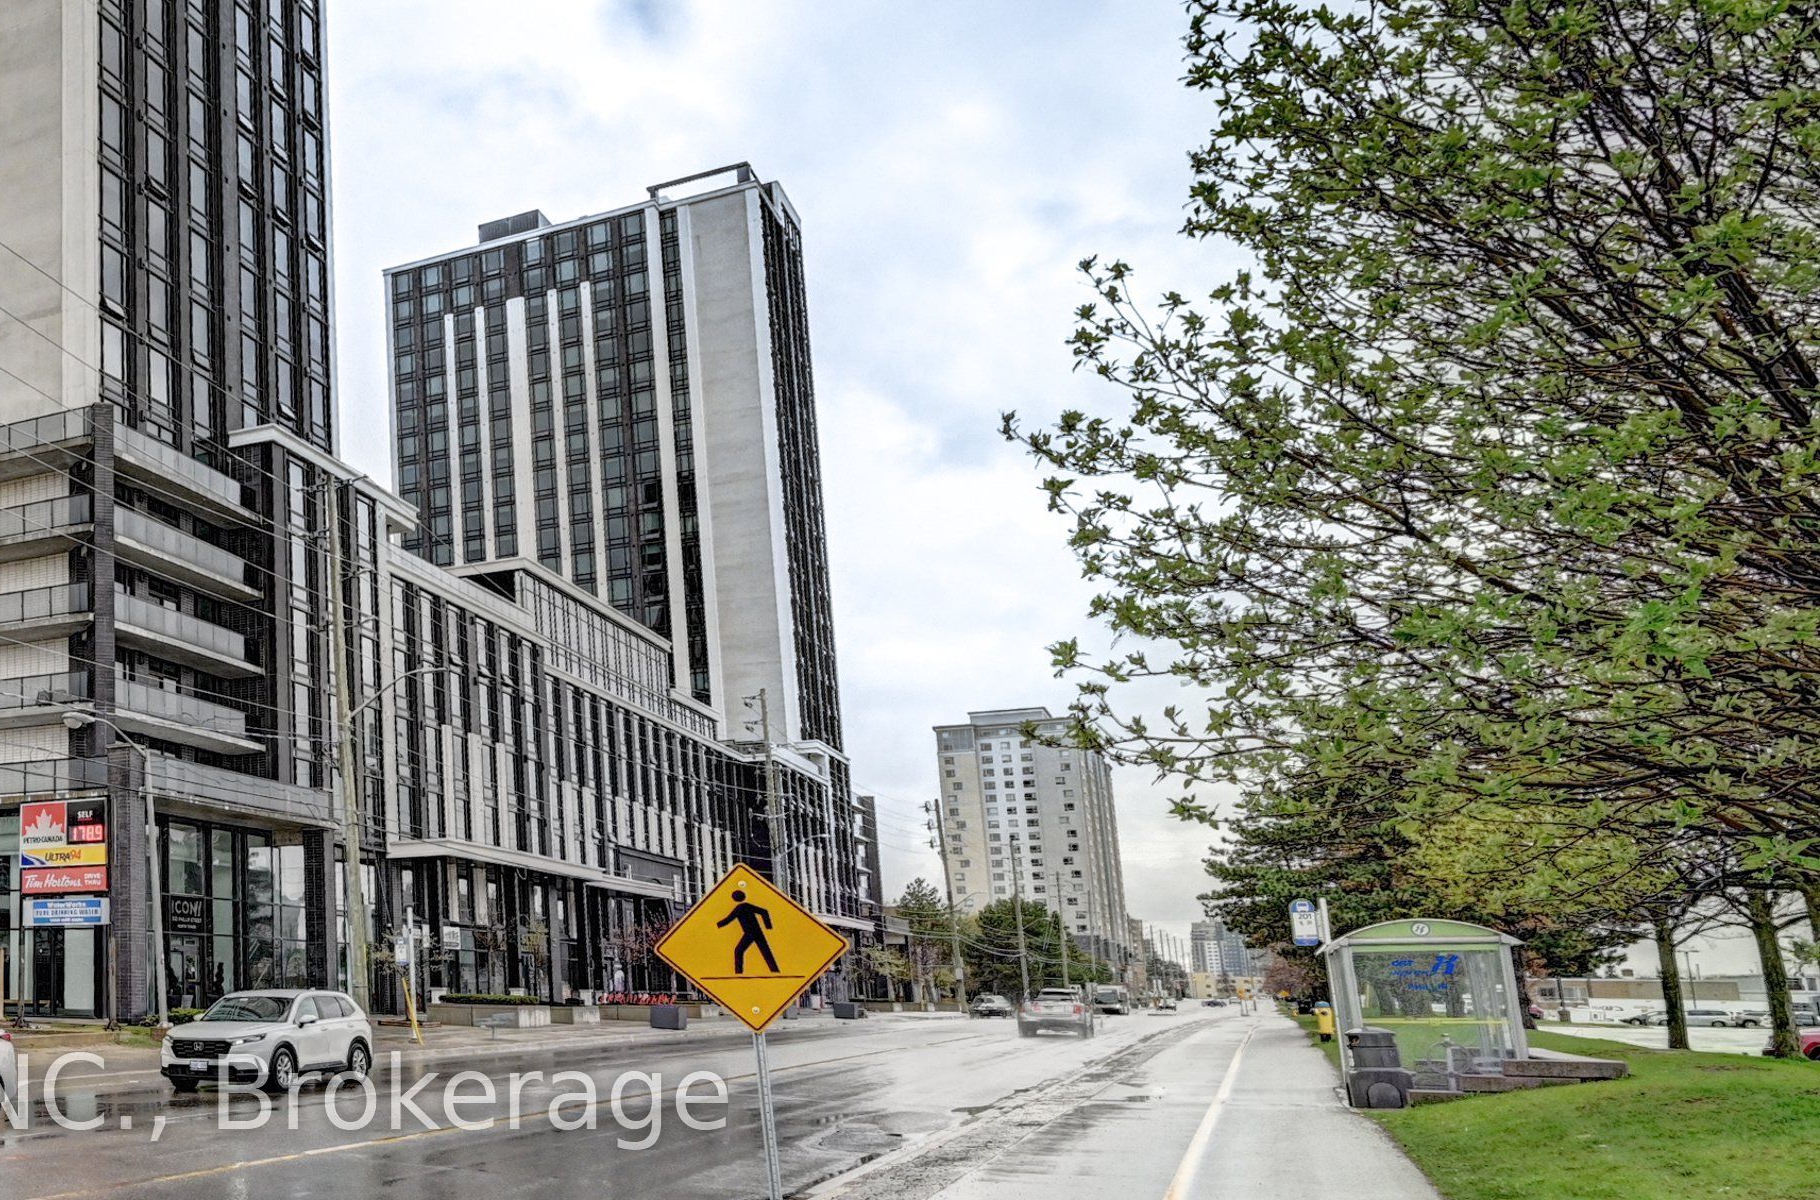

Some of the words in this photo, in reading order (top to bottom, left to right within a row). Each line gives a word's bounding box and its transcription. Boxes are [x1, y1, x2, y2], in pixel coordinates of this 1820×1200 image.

[77, 810, 93, 818] SELF
[24, 874, 43, 889] Tim
[43, 873, 81, 888] Hortons
